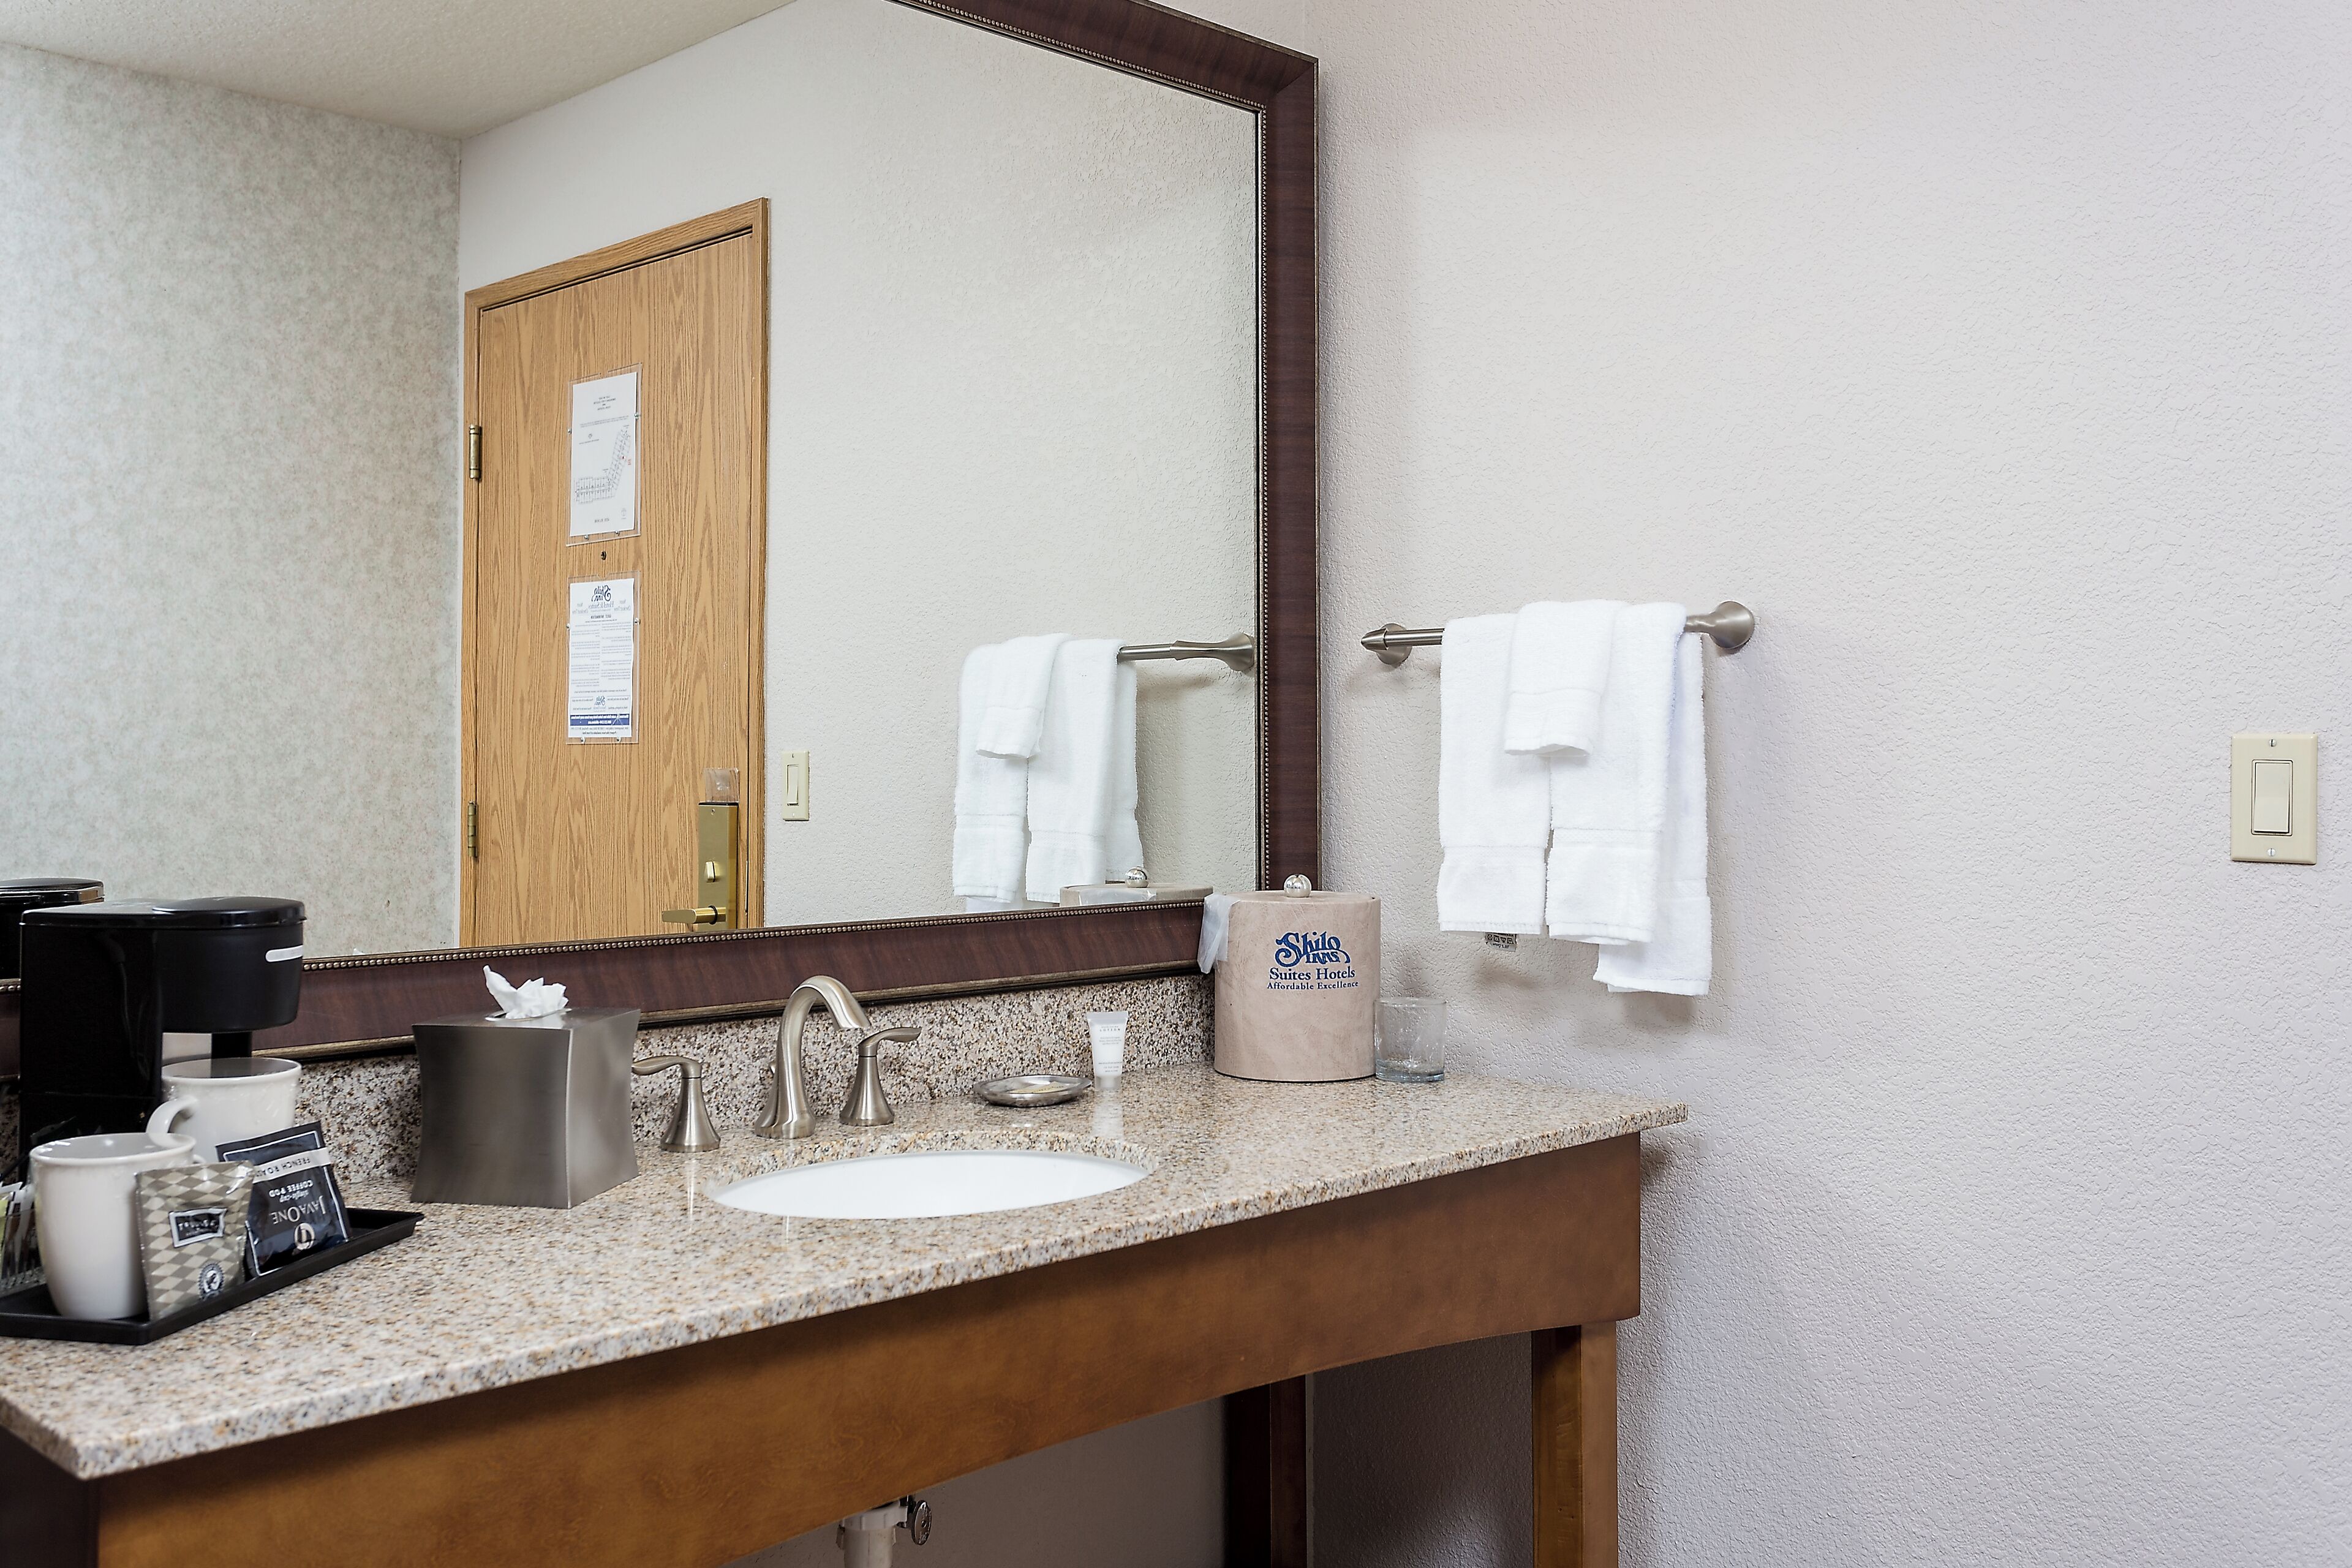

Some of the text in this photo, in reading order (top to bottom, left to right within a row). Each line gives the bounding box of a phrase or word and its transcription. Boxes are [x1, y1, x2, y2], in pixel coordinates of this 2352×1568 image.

[1275, 931, 1351, 967] Shilo
[1269, 966, 1355, 980] Suites Hotels
[281, 1157, 311, 1169] FRENCH
[269, 1180, 314, 1197] COFFEE POD
